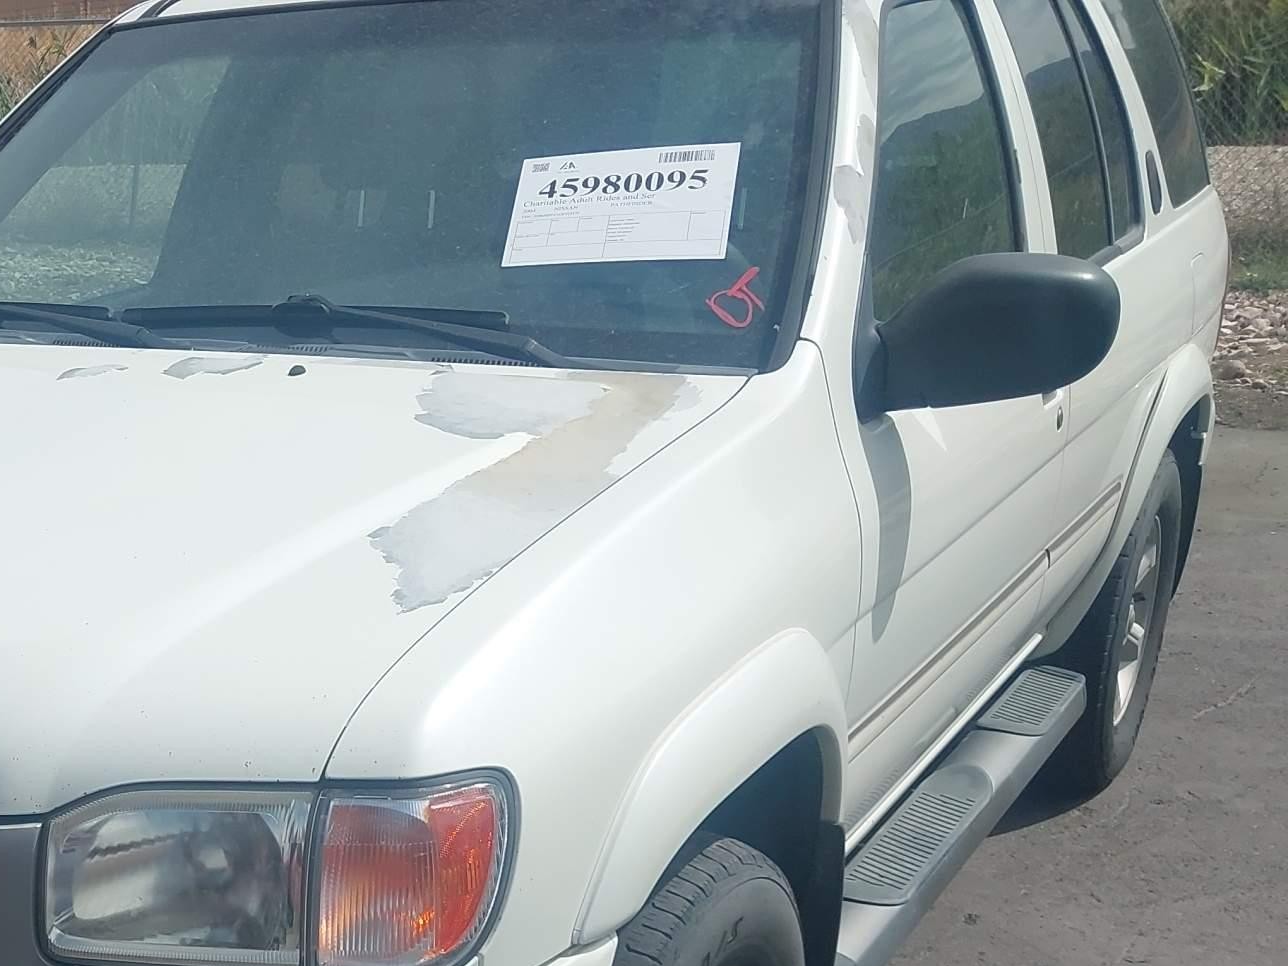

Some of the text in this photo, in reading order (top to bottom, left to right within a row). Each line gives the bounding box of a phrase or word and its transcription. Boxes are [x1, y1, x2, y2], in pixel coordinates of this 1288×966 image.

[538, 168, 710, 199] 45980095
[570, 196, 593, 205] Adult
[622, 193, 638, 201] and
